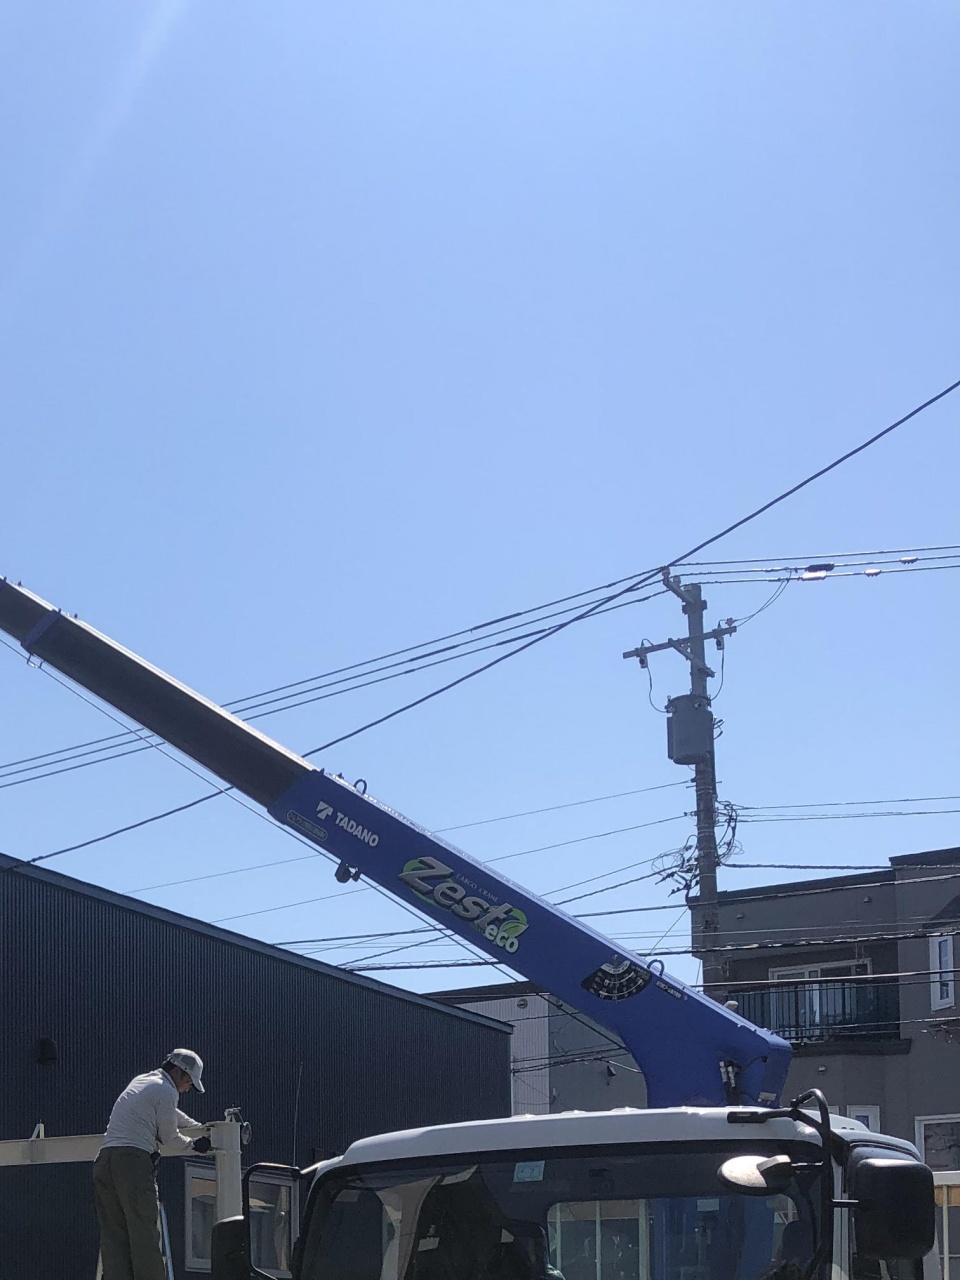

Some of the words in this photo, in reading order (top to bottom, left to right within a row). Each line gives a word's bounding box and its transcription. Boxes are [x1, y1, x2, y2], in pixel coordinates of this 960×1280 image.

[335, 812, 379, 847] TADANO
[398, 856, 513, 932] Zest
[485, 925, 519, 953] eco
